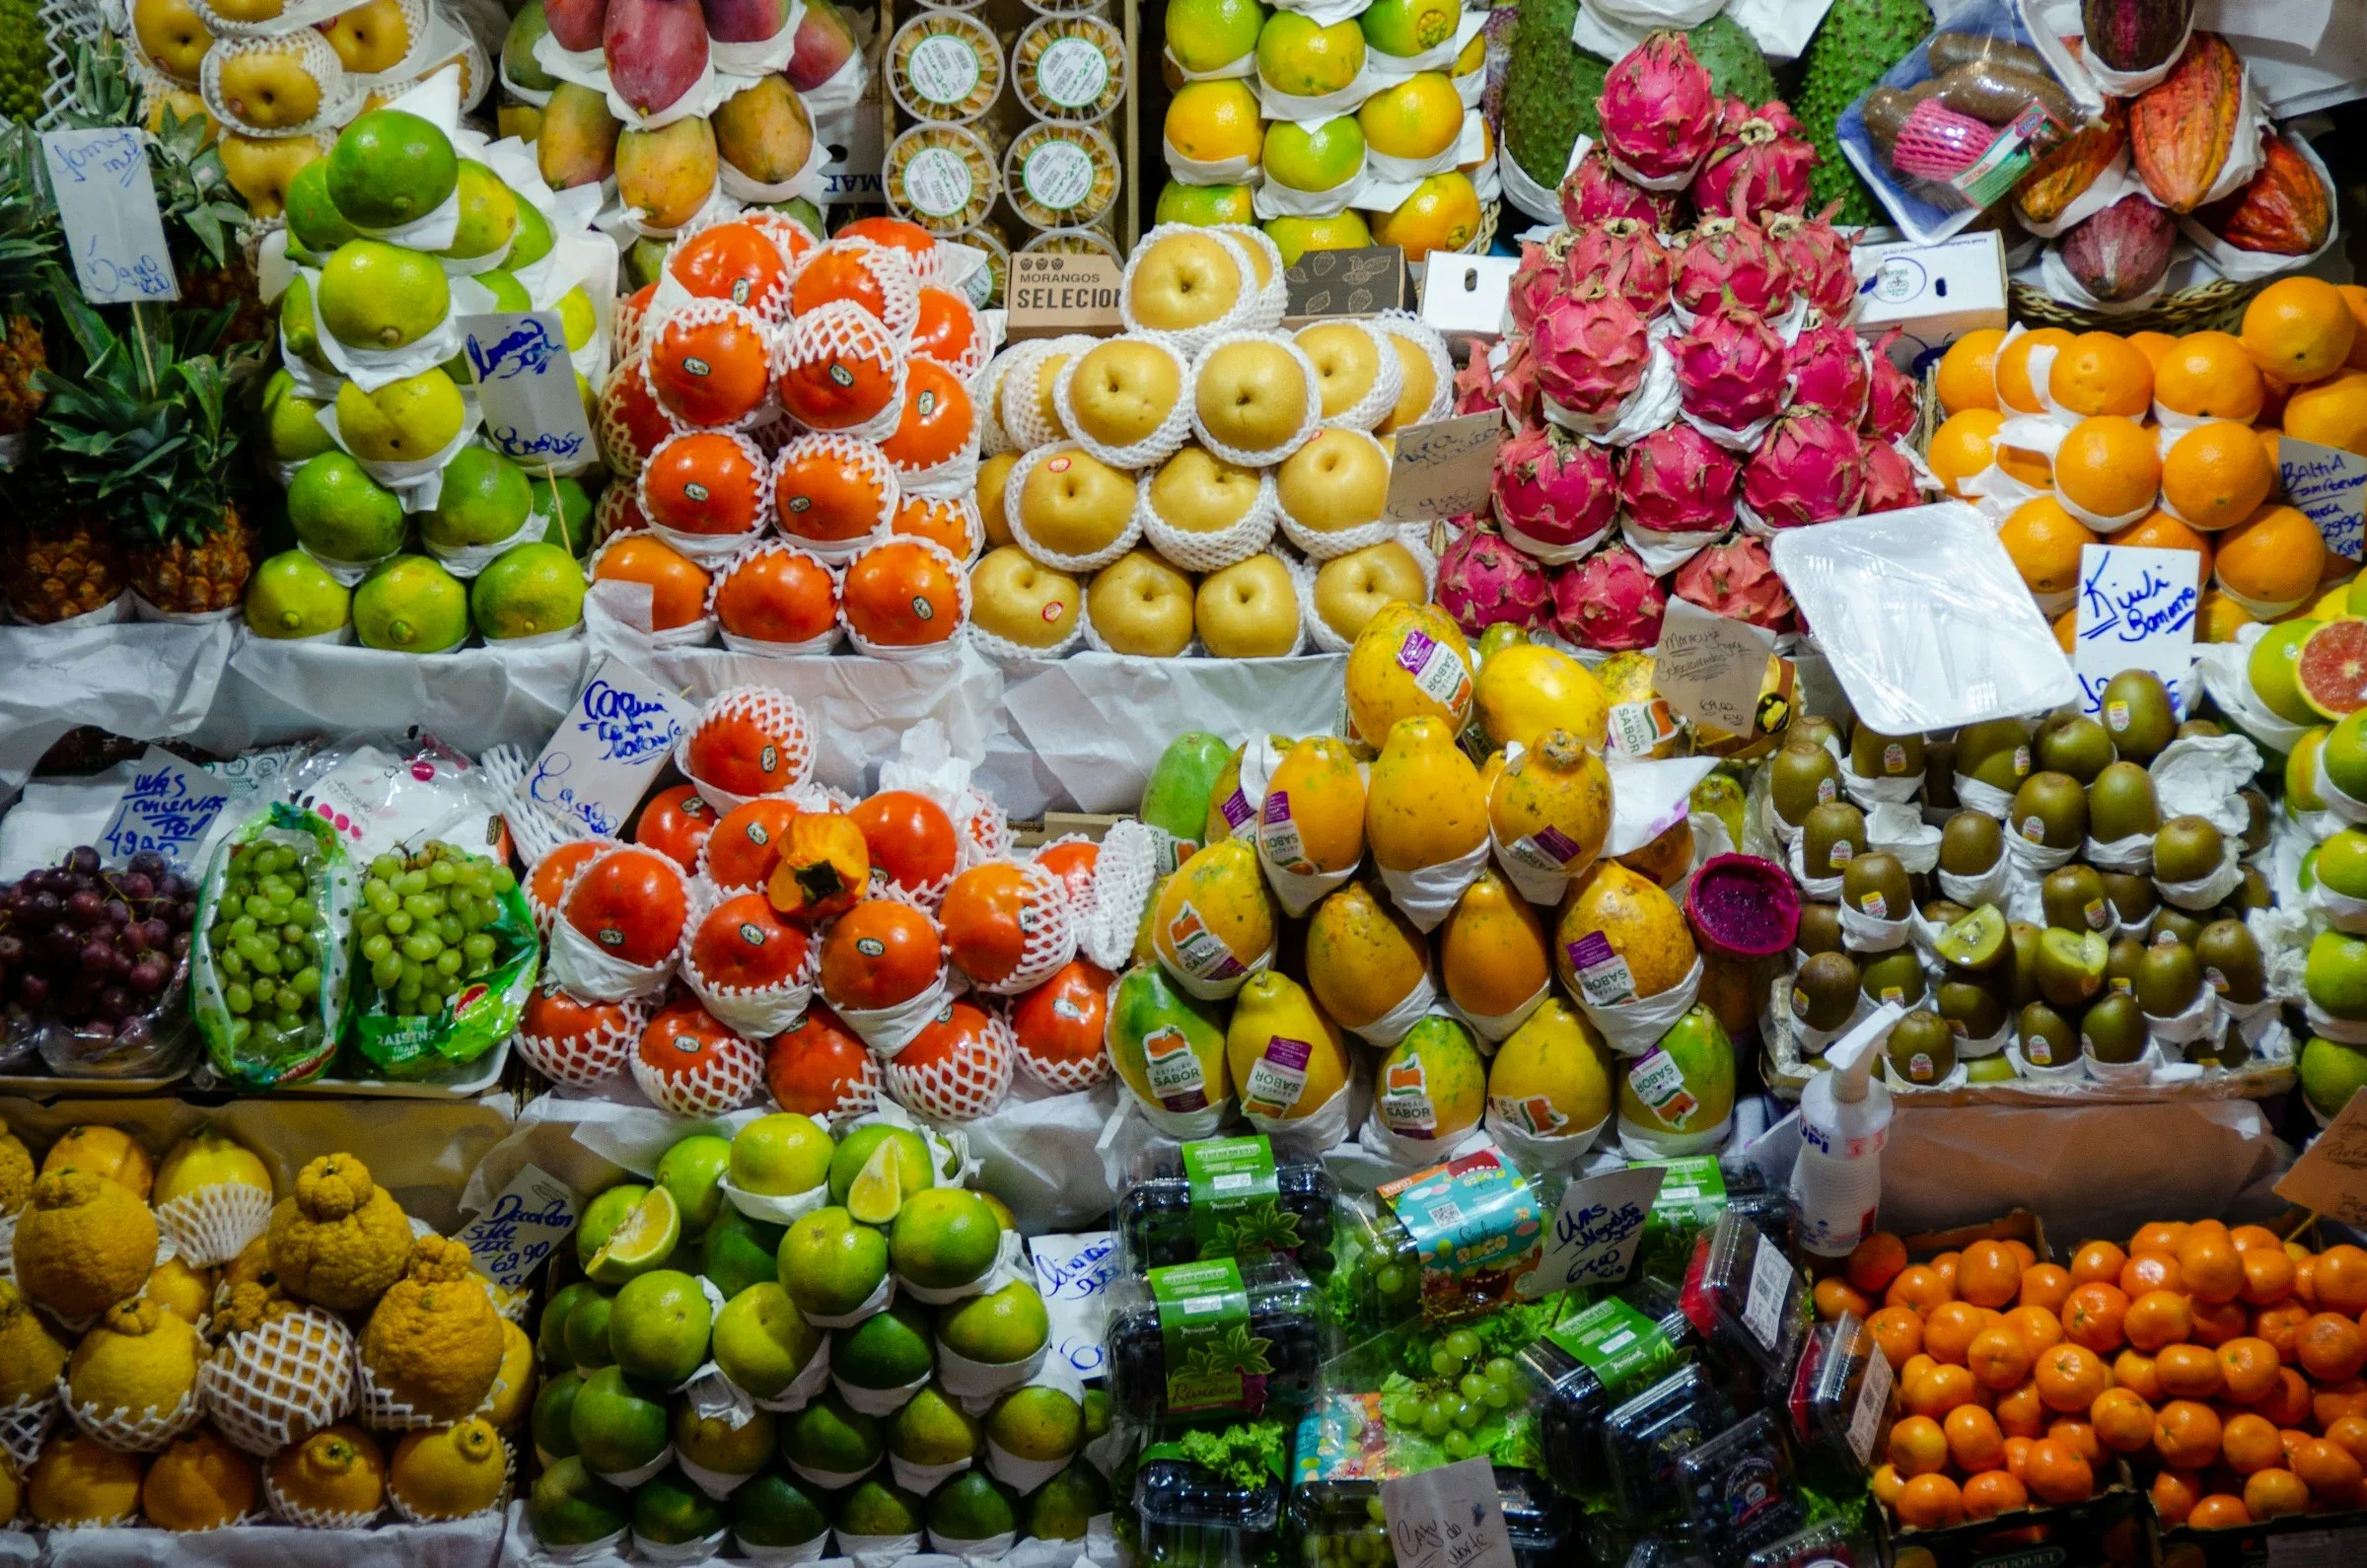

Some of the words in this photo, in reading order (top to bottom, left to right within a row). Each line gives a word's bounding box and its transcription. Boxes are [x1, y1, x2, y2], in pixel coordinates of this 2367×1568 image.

[1020, 273, 1101, 283] MORANGOS
[1426, 652, 1456, 692] SABOR
[1618, 707, 1641, 753] SABOR
[1584, 968, 1628, 990] SABOR
[1153, 1066, 1200, 1088] SABOR
[1255, 1070, 1302, 1093] SABOR
[1636, 1064, 1675, 1093] SABOR
[1386, 1107, 1431, 1118] SABOR
